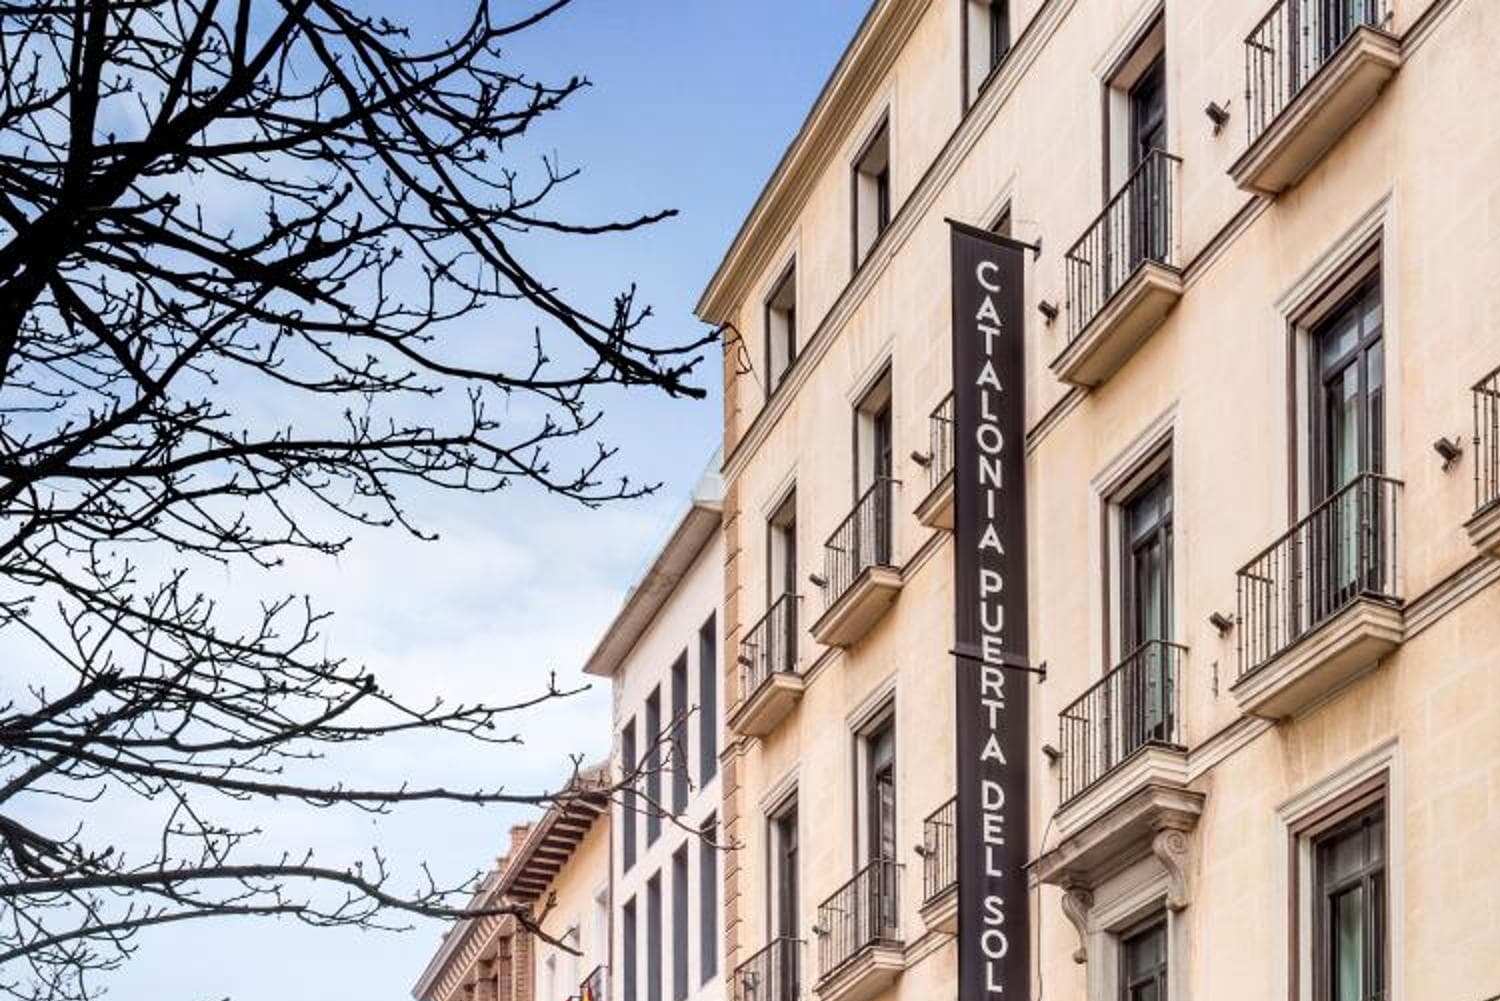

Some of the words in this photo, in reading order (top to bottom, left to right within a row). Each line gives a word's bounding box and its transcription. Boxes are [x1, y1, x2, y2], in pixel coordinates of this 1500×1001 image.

[975, 261, 1005, 555] CATALONIA
[980, 568, 1006, 764] PUERTA
[981, 780, 1006, 878] DEL
[981, 895, 1009, 993] SOL
